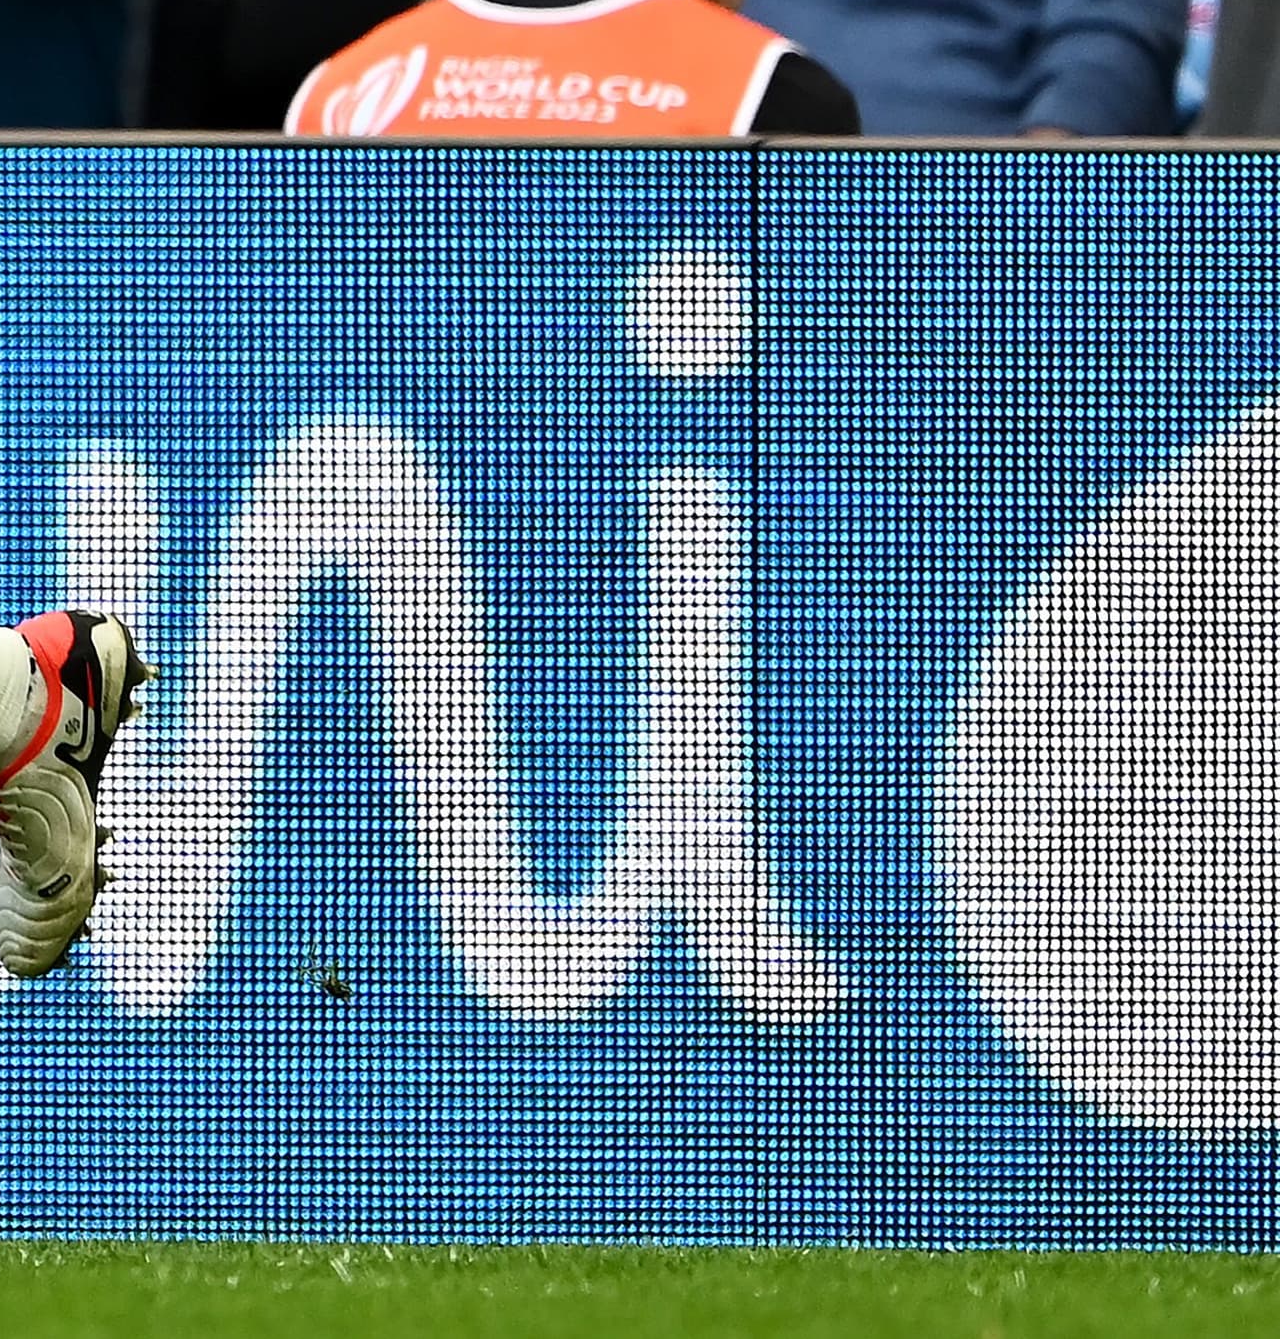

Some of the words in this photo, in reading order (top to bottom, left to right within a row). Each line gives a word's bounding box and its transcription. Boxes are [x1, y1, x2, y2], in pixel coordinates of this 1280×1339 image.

[440, 57, 543, 78] RUGBY
[432, 72, 593, 102] WORLD
[598, 74, 688, 113] CUP
[417, 97, 530, 121] FRANCE
[535, 99, 617, 124] 2023
